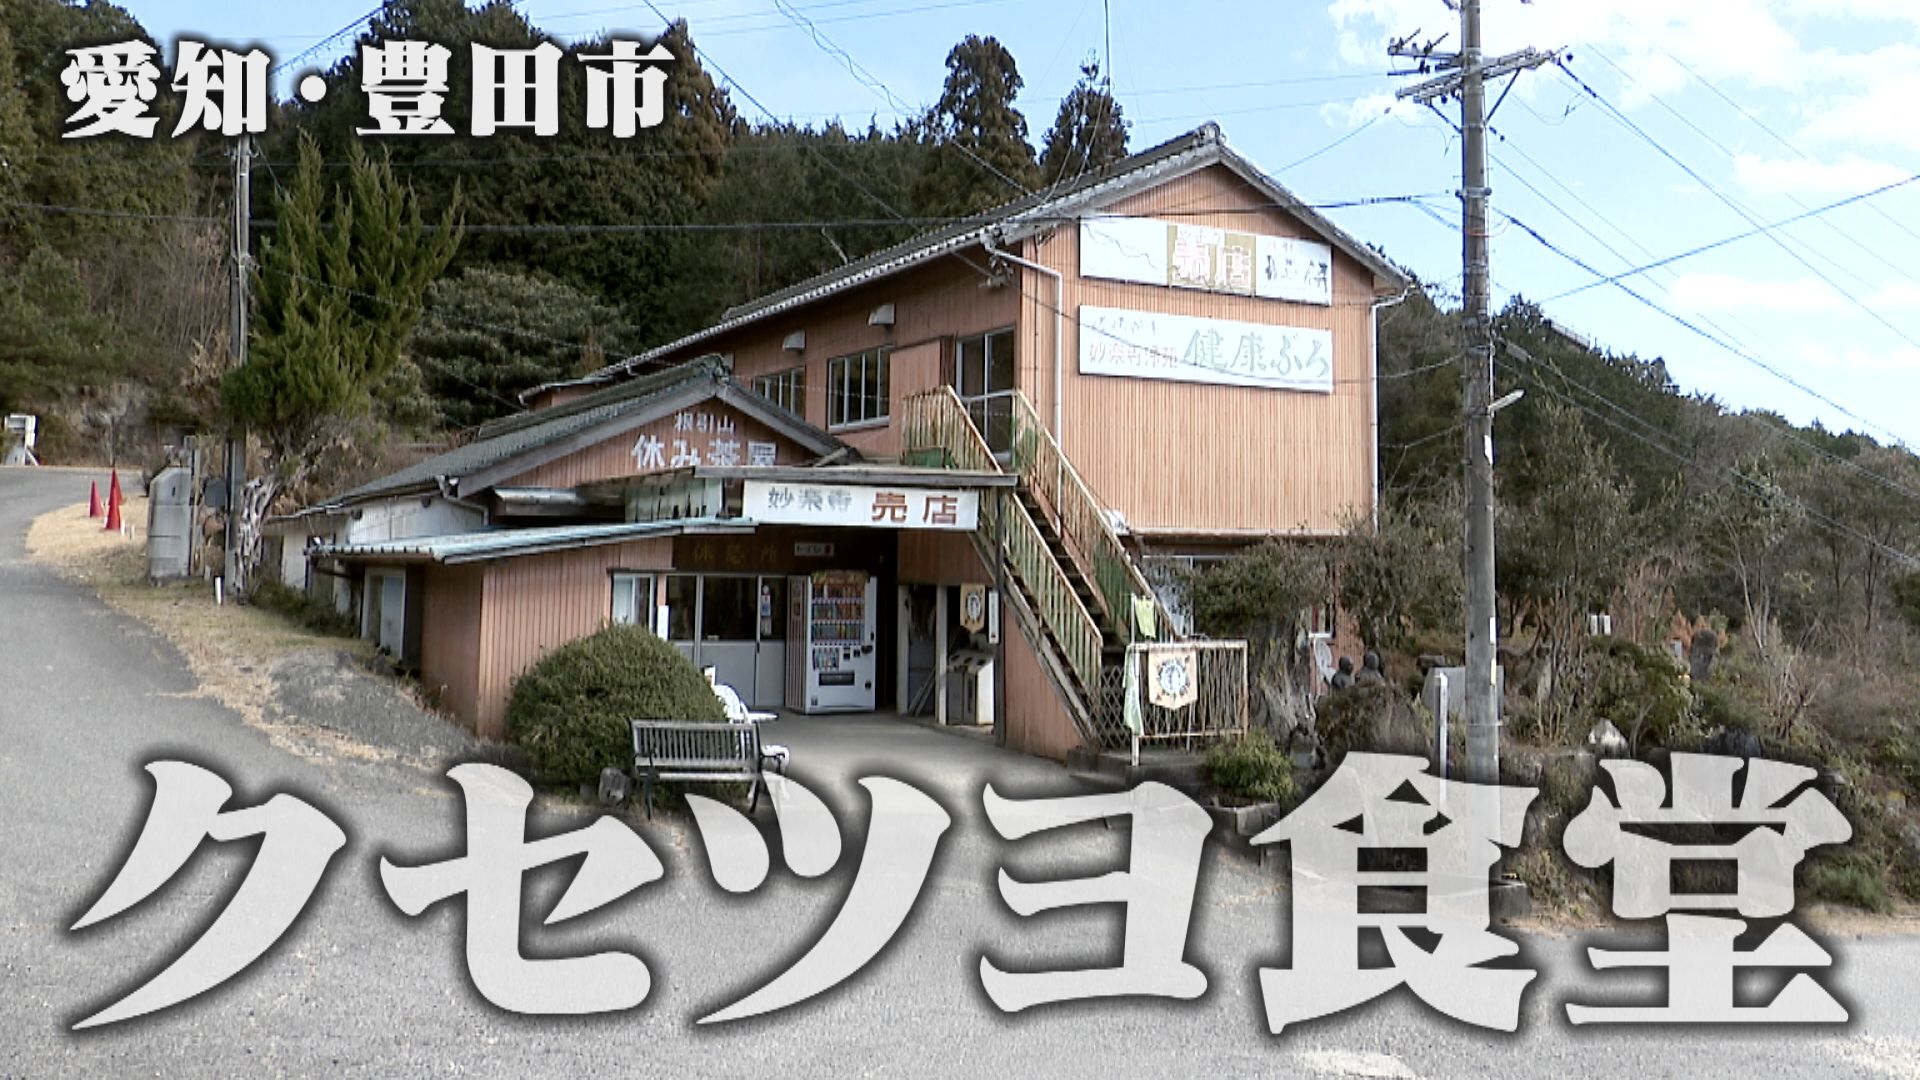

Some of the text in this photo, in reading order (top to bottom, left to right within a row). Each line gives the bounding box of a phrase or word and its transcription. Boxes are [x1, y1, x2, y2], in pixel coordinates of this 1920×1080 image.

[631, 434, 776, 470] 休み茶屋
[871, 492, 959, 525] 売店
